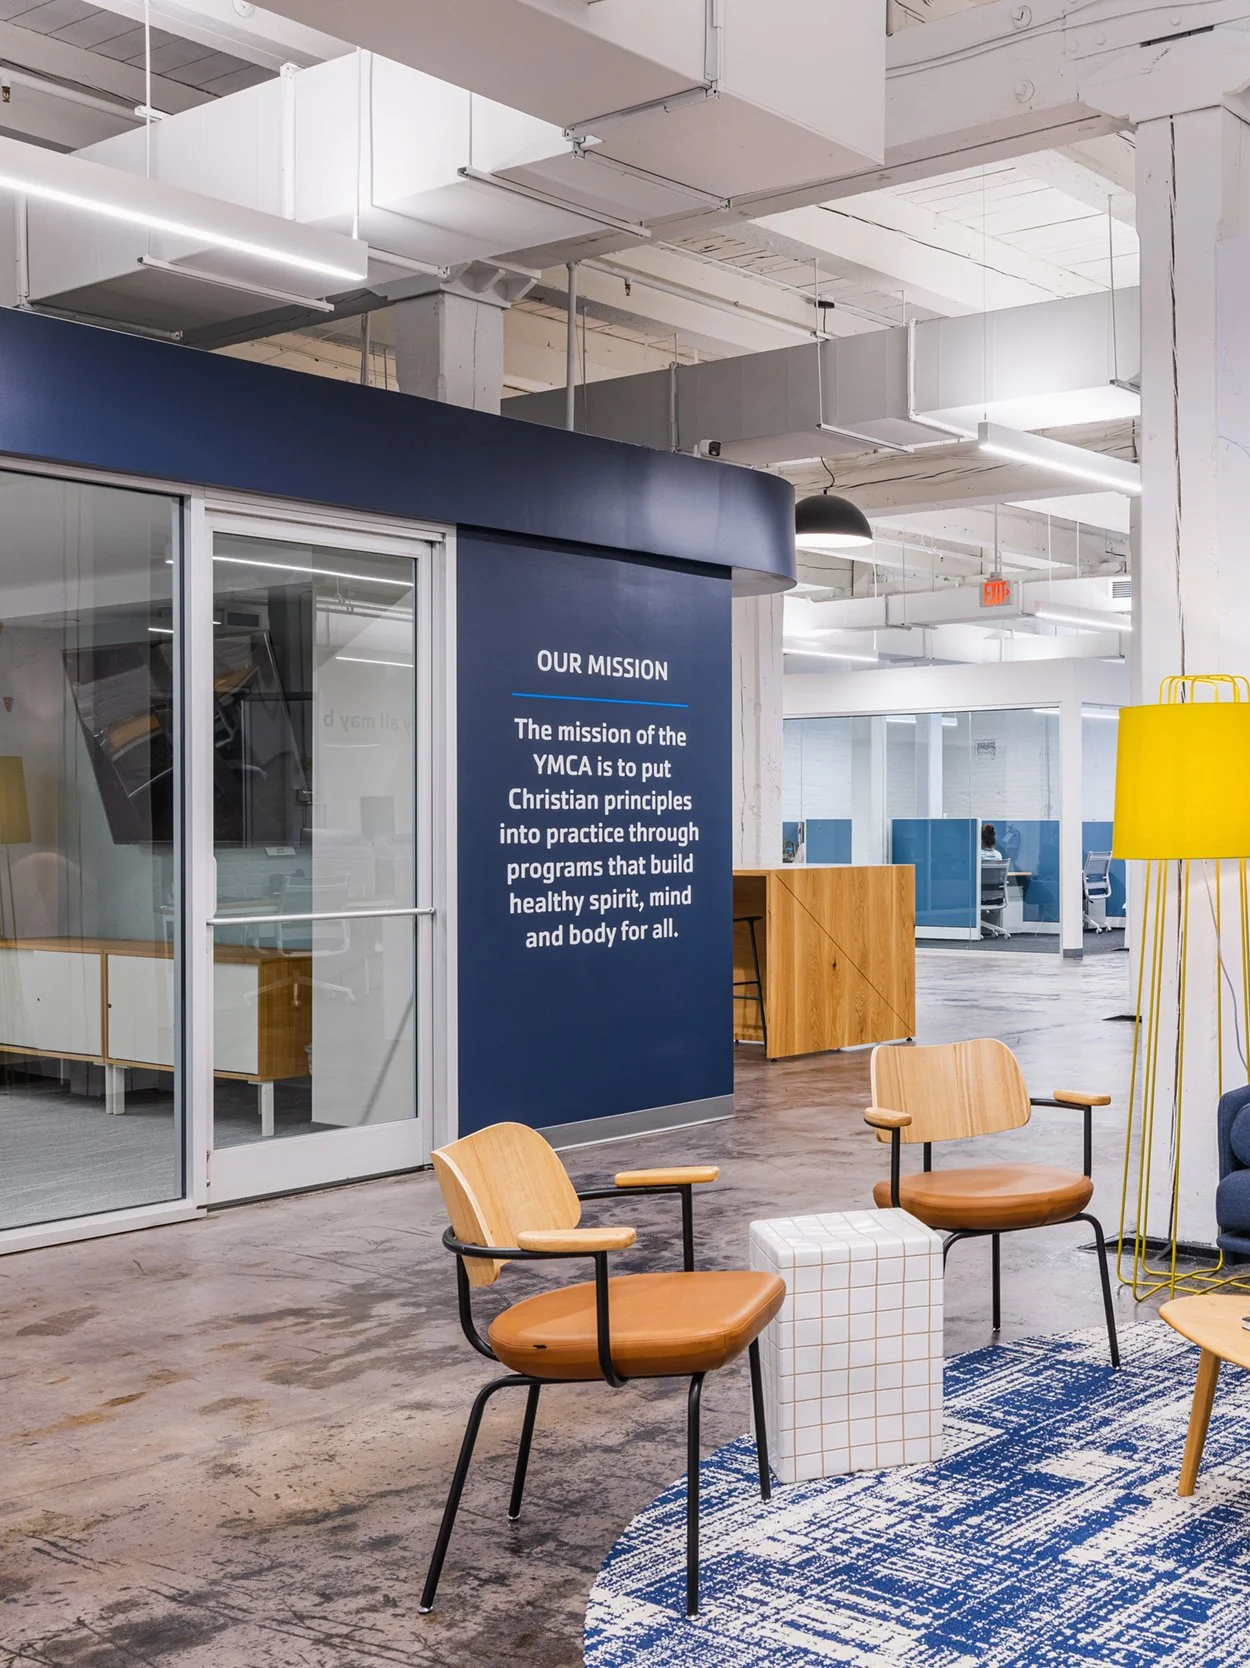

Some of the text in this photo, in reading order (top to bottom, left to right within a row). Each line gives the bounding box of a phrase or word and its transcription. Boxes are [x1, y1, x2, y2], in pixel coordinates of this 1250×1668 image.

[984, 580, 1007, 606] EXIT
[538, 650, 668, 681] OUR MISSION
[514, 718, 686, 746] The mission of the
[533, 754, 671, 782] YMCA is to put
[509, 788, 692, 815] Christian principles
[500, 822, 699, 849] into practice through
[508, 853, 693, 885] programs that build
[510, 885, 691, 916] healthy spirit, mind
[526, 918, 678, 948] and body for all.
